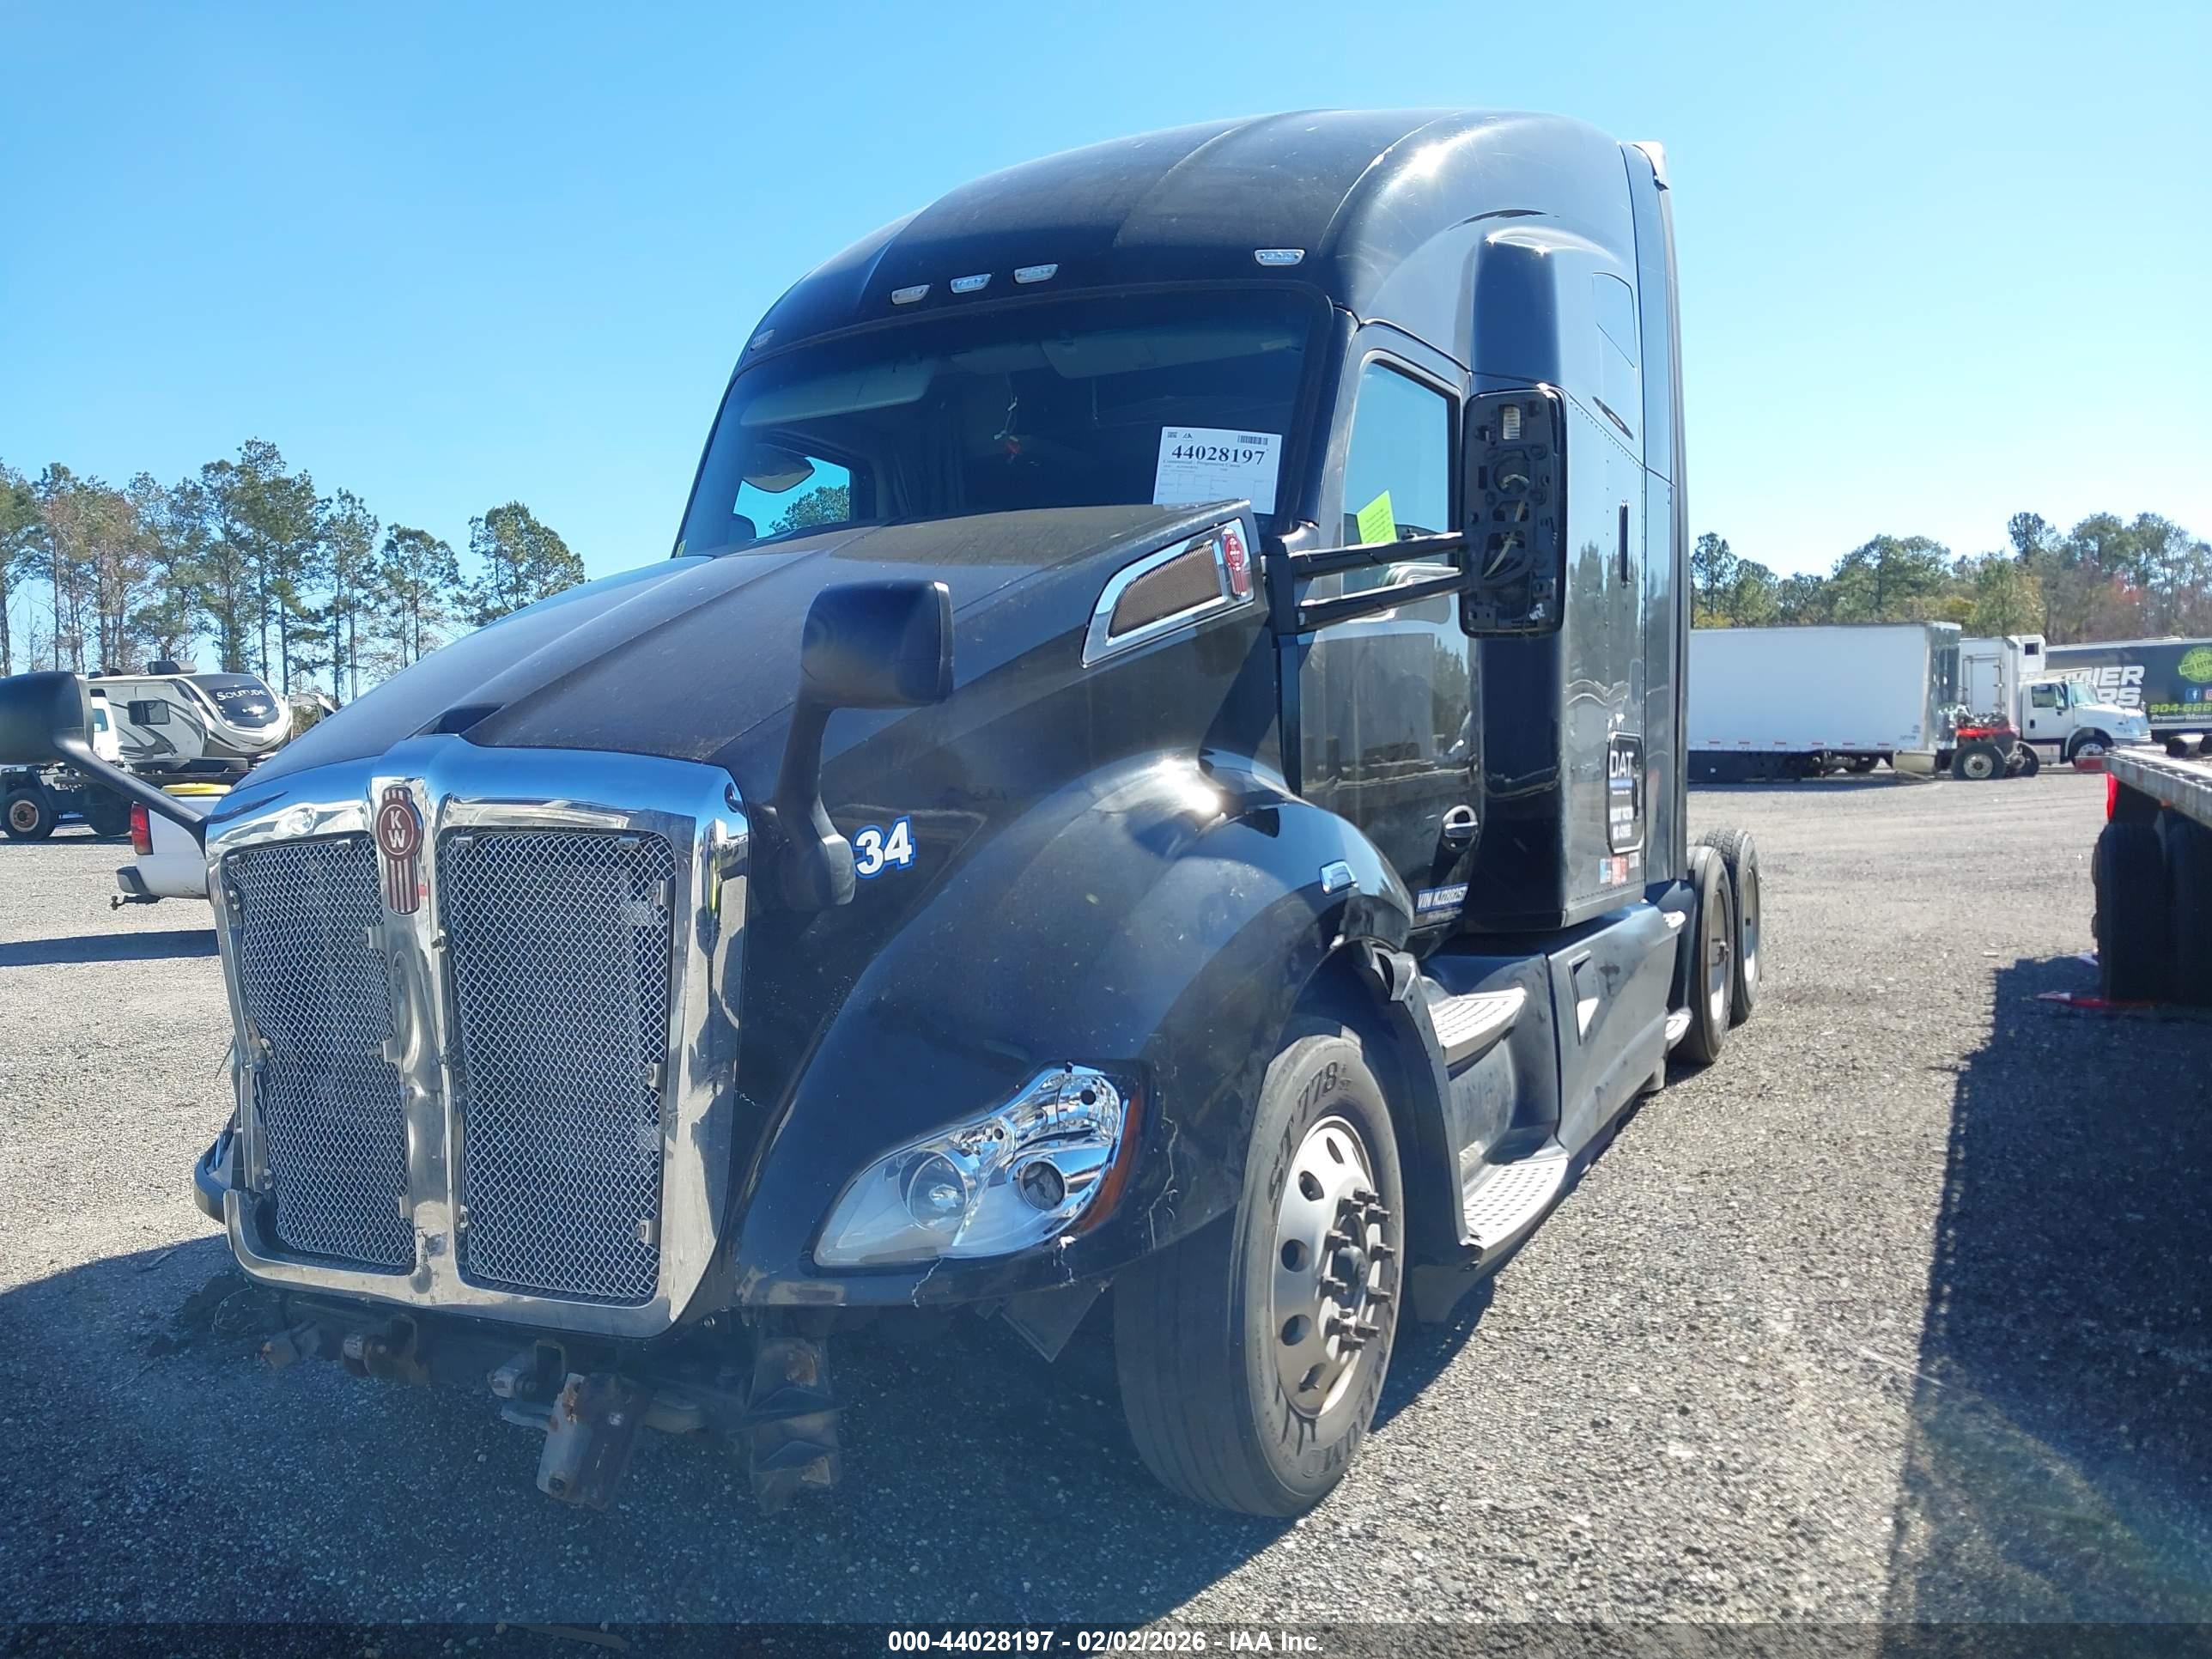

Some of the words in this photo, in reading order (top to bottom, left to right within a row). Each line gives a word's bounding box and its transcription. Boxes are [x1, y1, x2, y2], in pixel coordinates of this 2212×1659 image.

[1171, 445, 1265, 465] 44028197
[1609, 750, 1635, 778] DAT
[855, 821, 913, 875] 34
[1417, 892, 1432, 908] VIN
